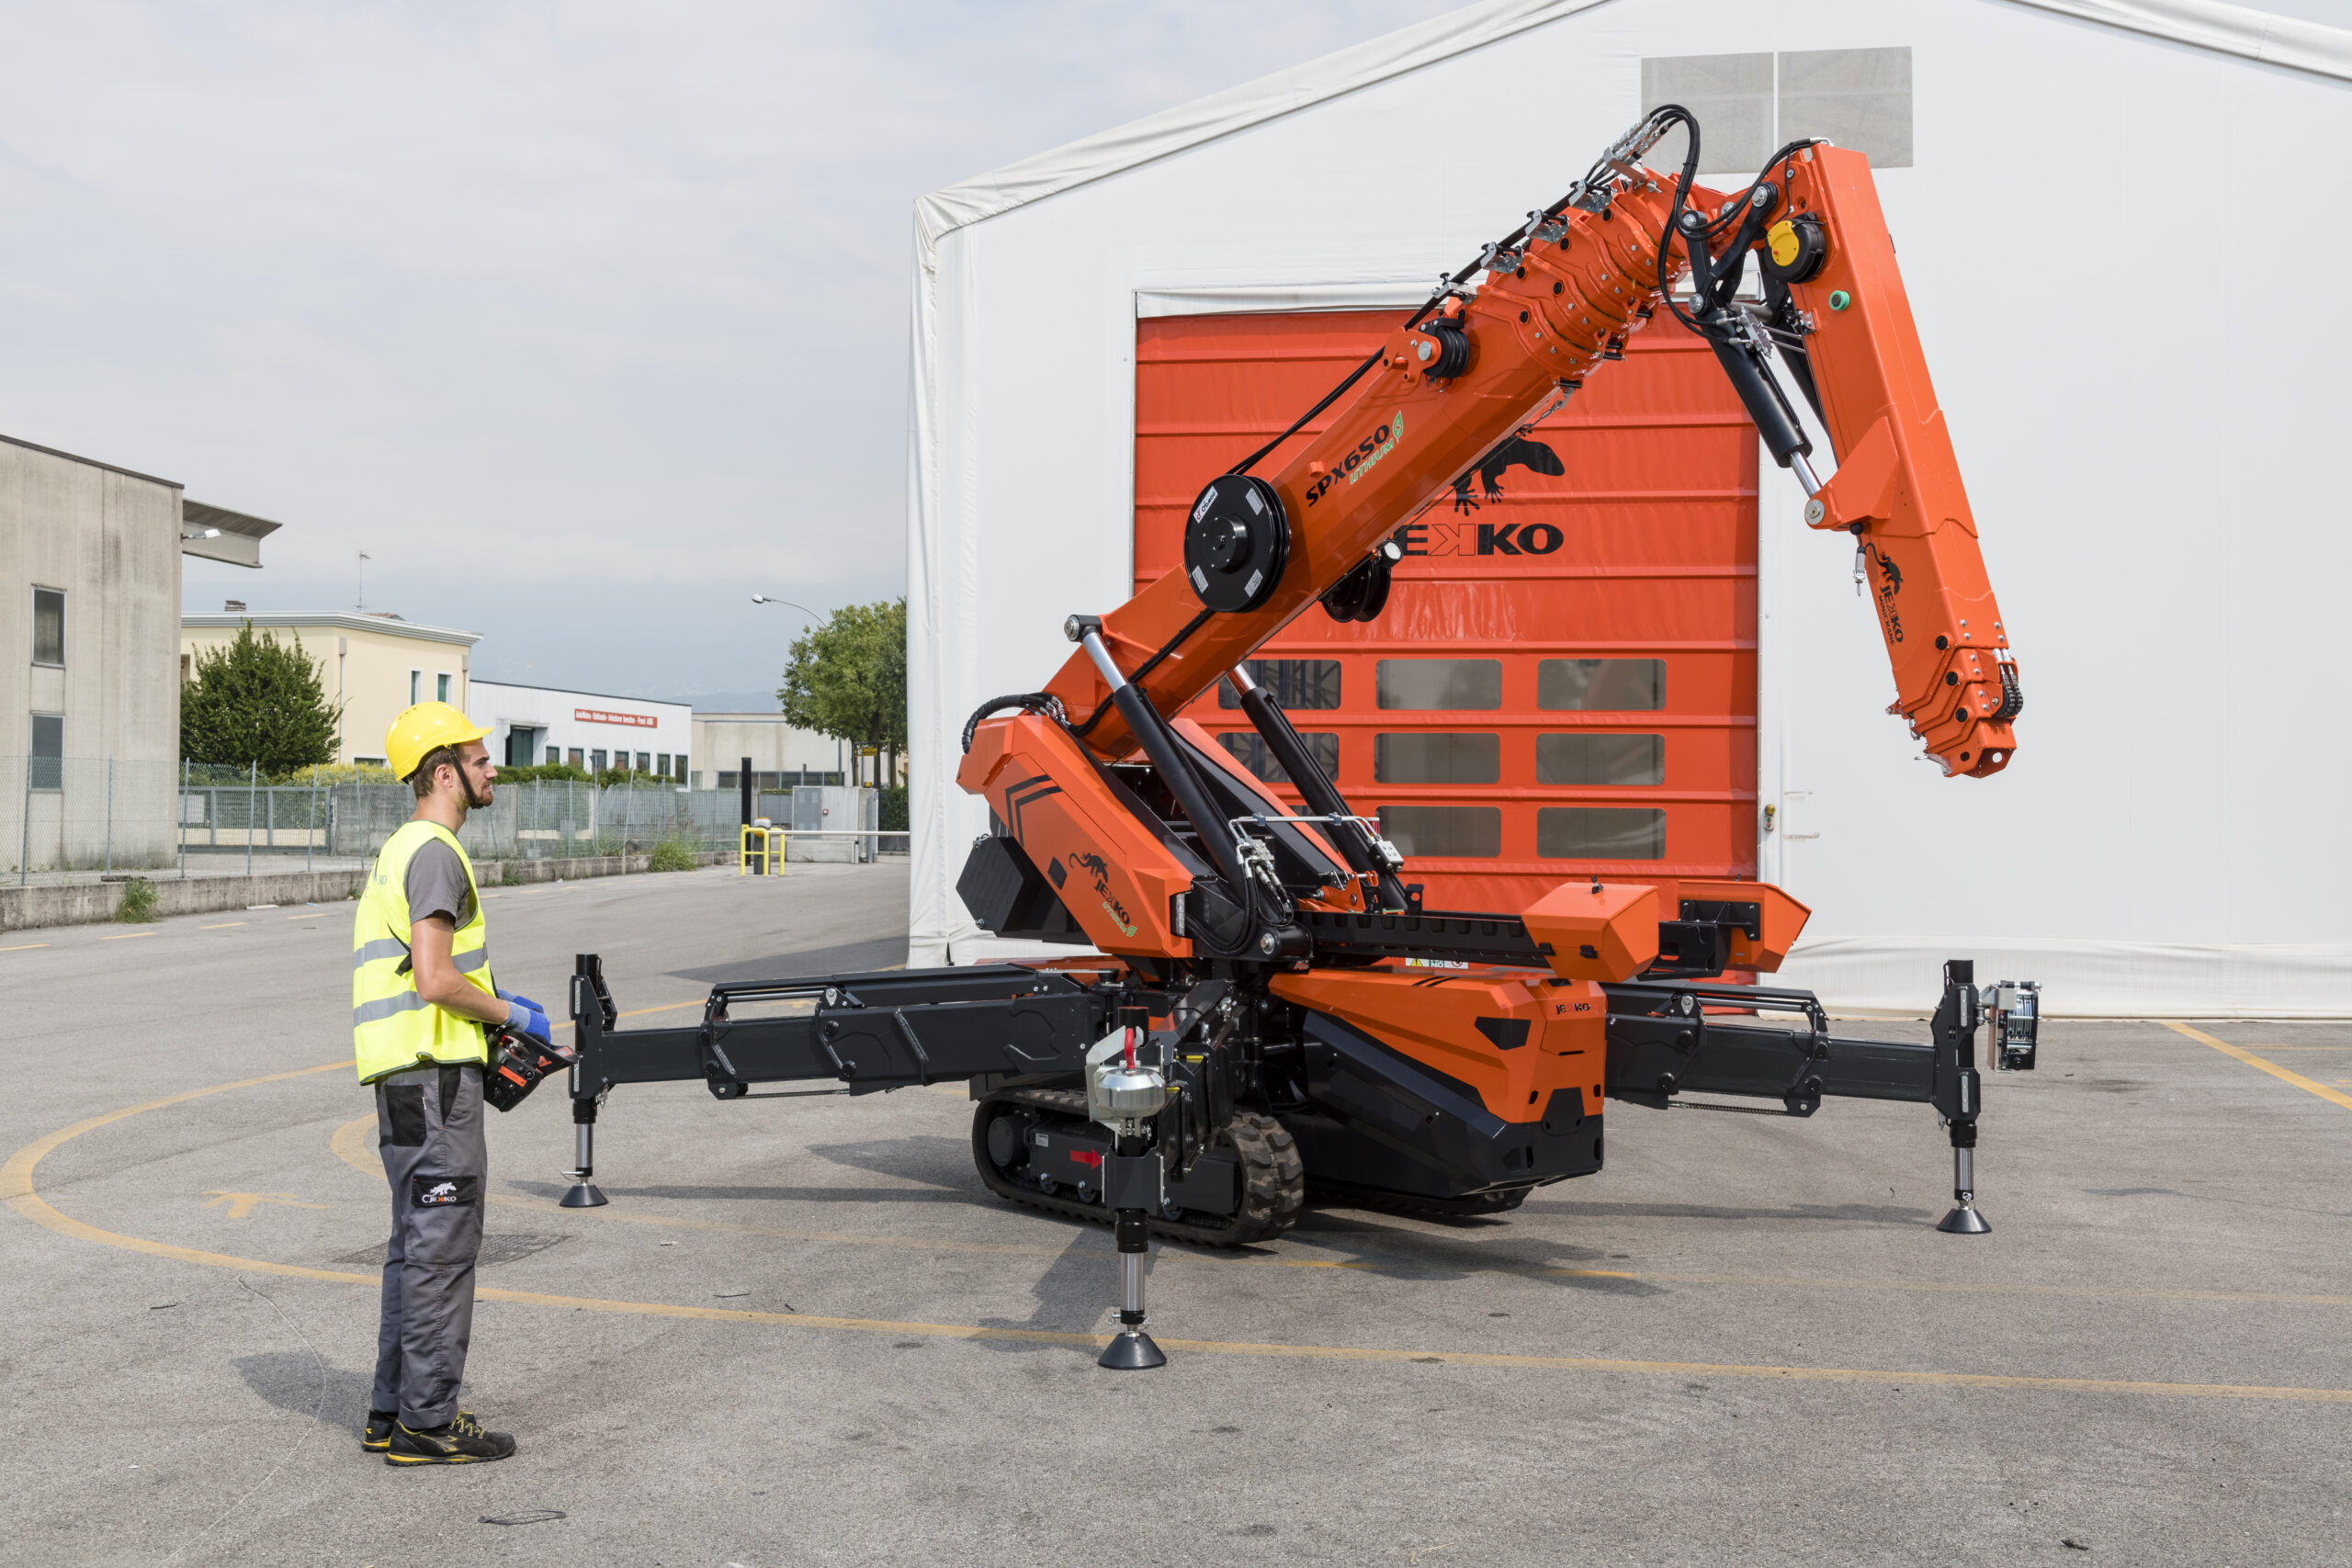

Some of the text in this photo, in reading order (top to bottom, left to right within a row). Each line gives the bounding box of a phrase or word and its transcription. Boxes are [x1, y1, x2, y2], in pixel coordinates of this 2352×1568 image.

[1306, 424, 1389, 507] SPX650
[1349, 437, 1394, 485] LITHIUM
[1393, 524, 1564, 557] EKKO
[1880, 585, 1904, 643] JEKKO
[1093, 879, 1130, 925] JEKKO
[1555, 1003, 1590, 1014] JEKO
